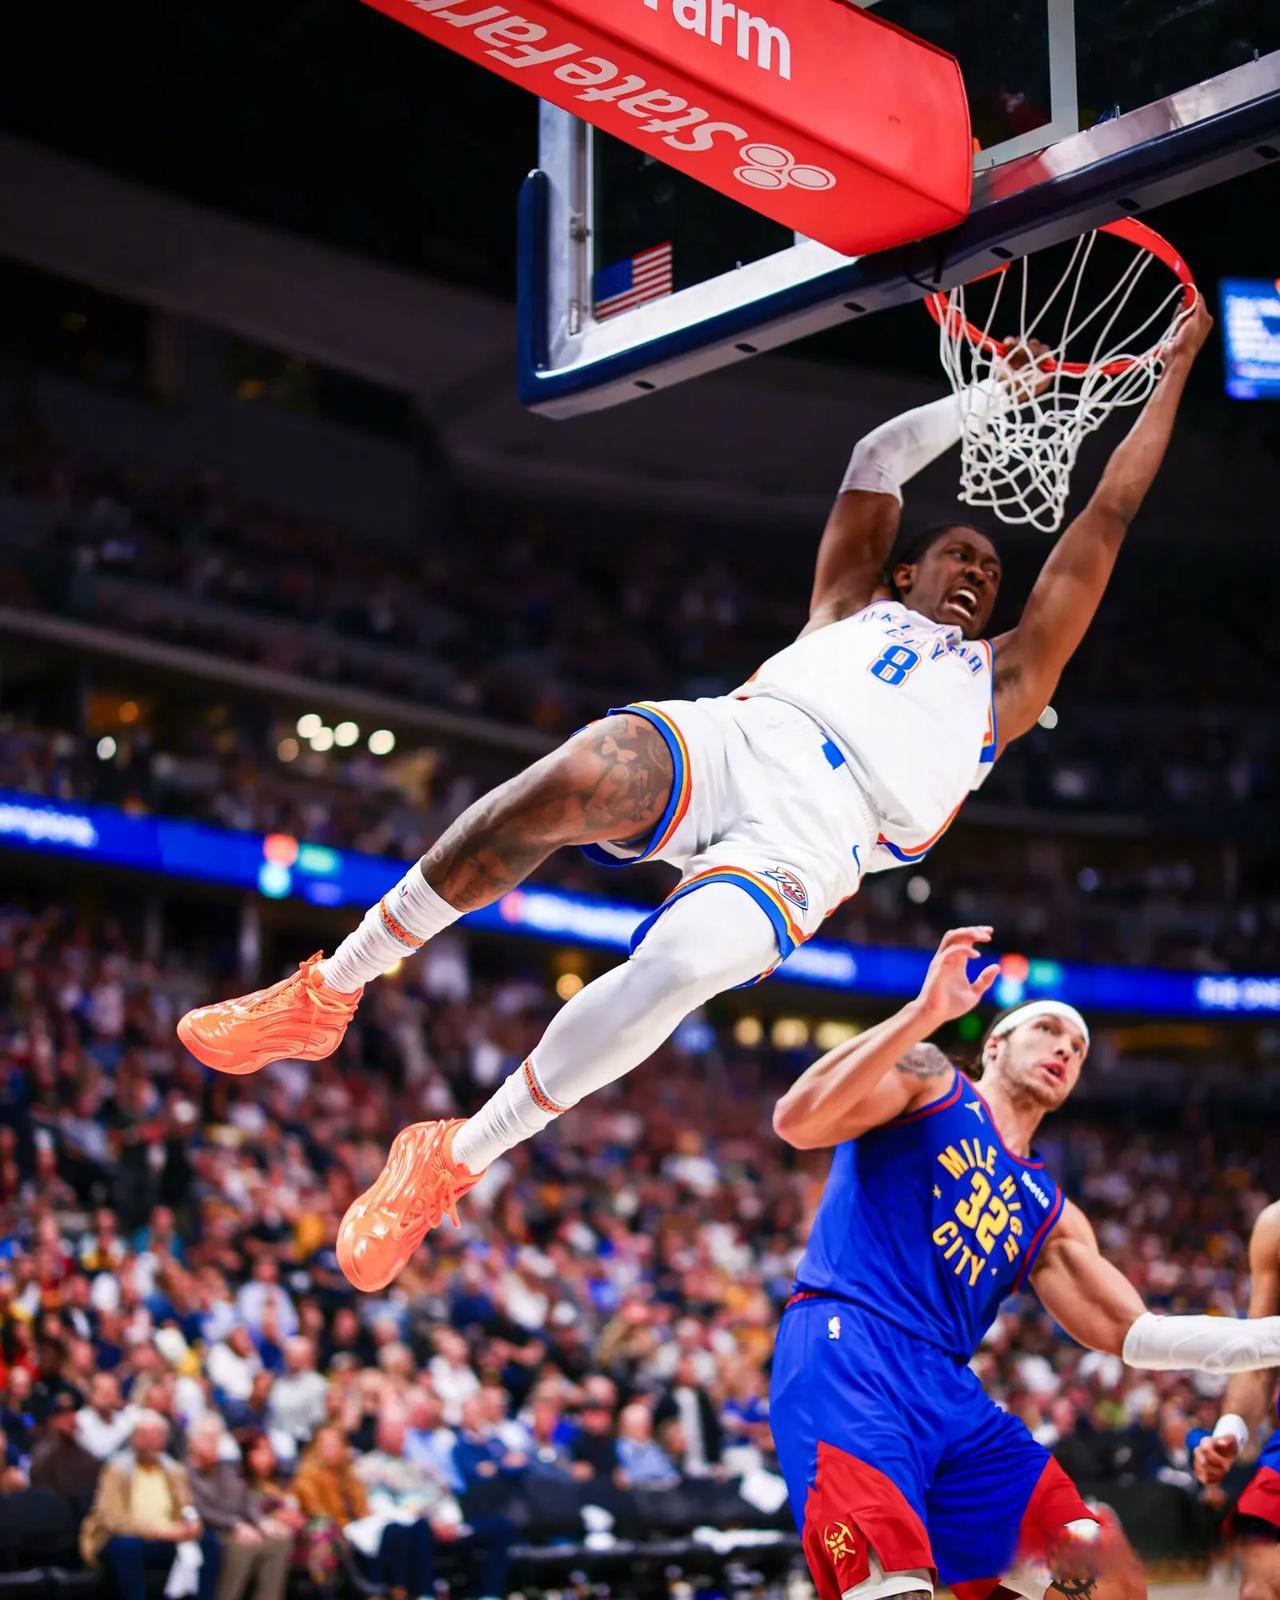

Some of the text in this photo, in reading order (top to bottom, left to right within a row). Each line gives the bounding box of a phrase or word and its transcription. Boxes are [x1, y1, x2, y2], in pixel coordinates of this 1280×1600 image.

[644, 0, 791, 81] arm
[868, 642, 921, 687] 8
[932, 1138, 1023, 1287] MILE HIGH CITY
[954, 1170, 1010, 1255] 32
